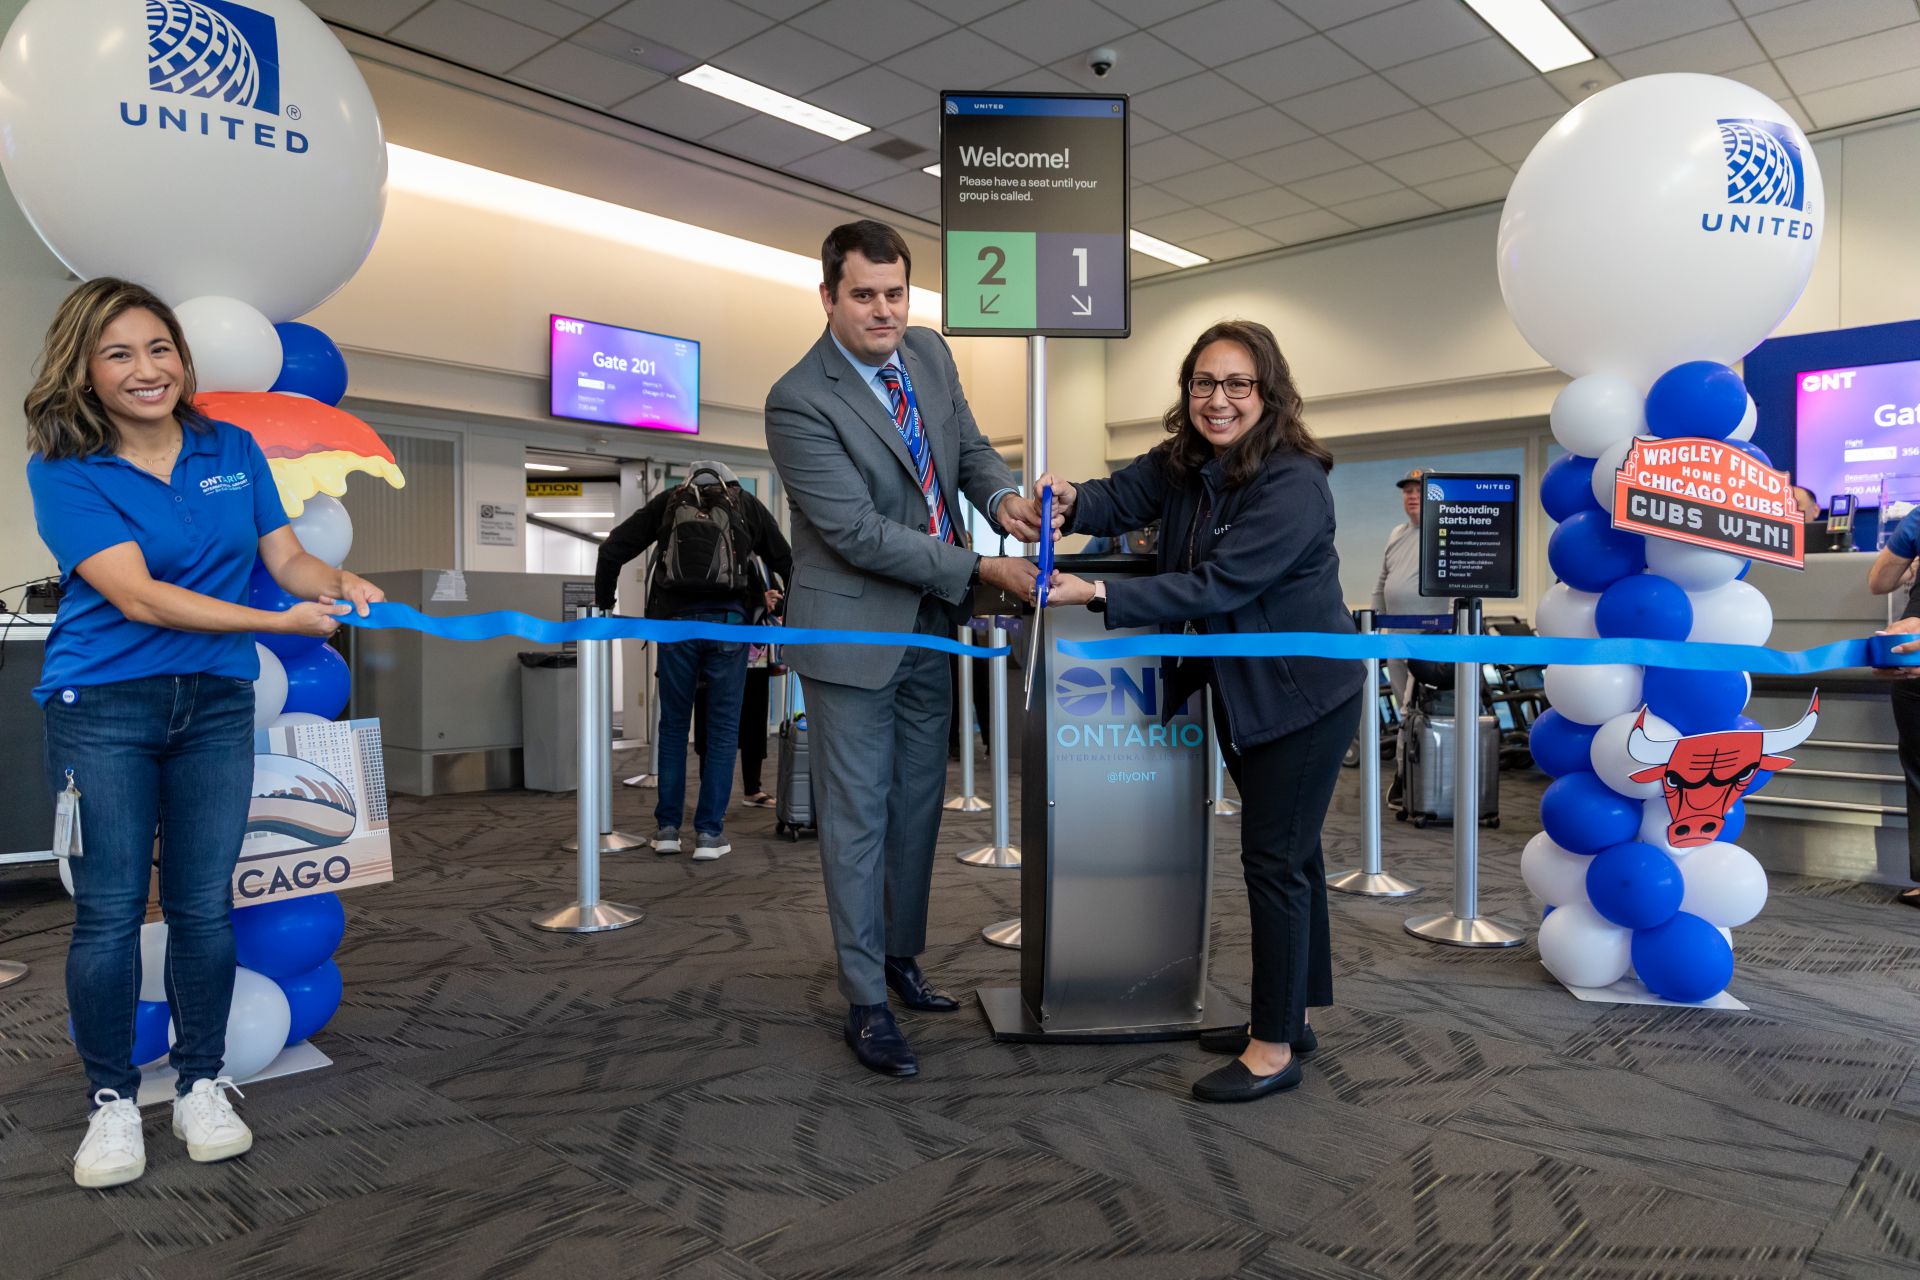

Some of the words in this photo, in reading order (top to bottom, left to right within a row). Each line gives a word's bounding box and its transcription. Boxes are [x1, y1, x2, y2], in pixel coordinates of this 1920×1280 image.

[120, 101, 309, 154] UNITED
[959, 146, 1070, 169] Welcome!
[959, 176, 993, 187] Please
[994, 176, 1019, 187] have
[1020, 179, 1027, 187] a
[1028, 178, 1050, 188] seat
[1052, 178, 1073, 188] until
[1075, 179, 1098, 190] your
[959, 192, 990, 203] group
[991, 191, 999, 201] is
[1000, 191, 1033, 202] called.
[1701, 213, 1813, 240] UNITED
[977, 246, 1007, 286] 2
[1072, 247, 1088, 287] 1
[593, 351, 628, 371] Gate
[631, 358, 656, 376] 201
[1802, 371, 1856, 392] ONT
[1643, 445, 1724, 466] WRIGLEY
[1730, 455, 1781, 495] FIELD
[1682, 466, 1721, 484] HOME
[1728, 477, 1747, 489] OF
[527, 483, 578, 492] UTION
[1638, 471, 1727, 504] CHICAGO
[1732, 492, 1785, 517] CUBS
[1439, 504, 1500, 517] Preboarding
[1439, 516, 1468, 525] starts
[1469, 516, 1492, 525] here
[1631, 494, 1703, 530] CUBS
[1718, 513, 1789, 549] WIN!
[1056, 724, 1204, 748] ONTARIO
[1107, 771, 1157, 783] @flyONT
[238, 855, 351, 898] CAGO
